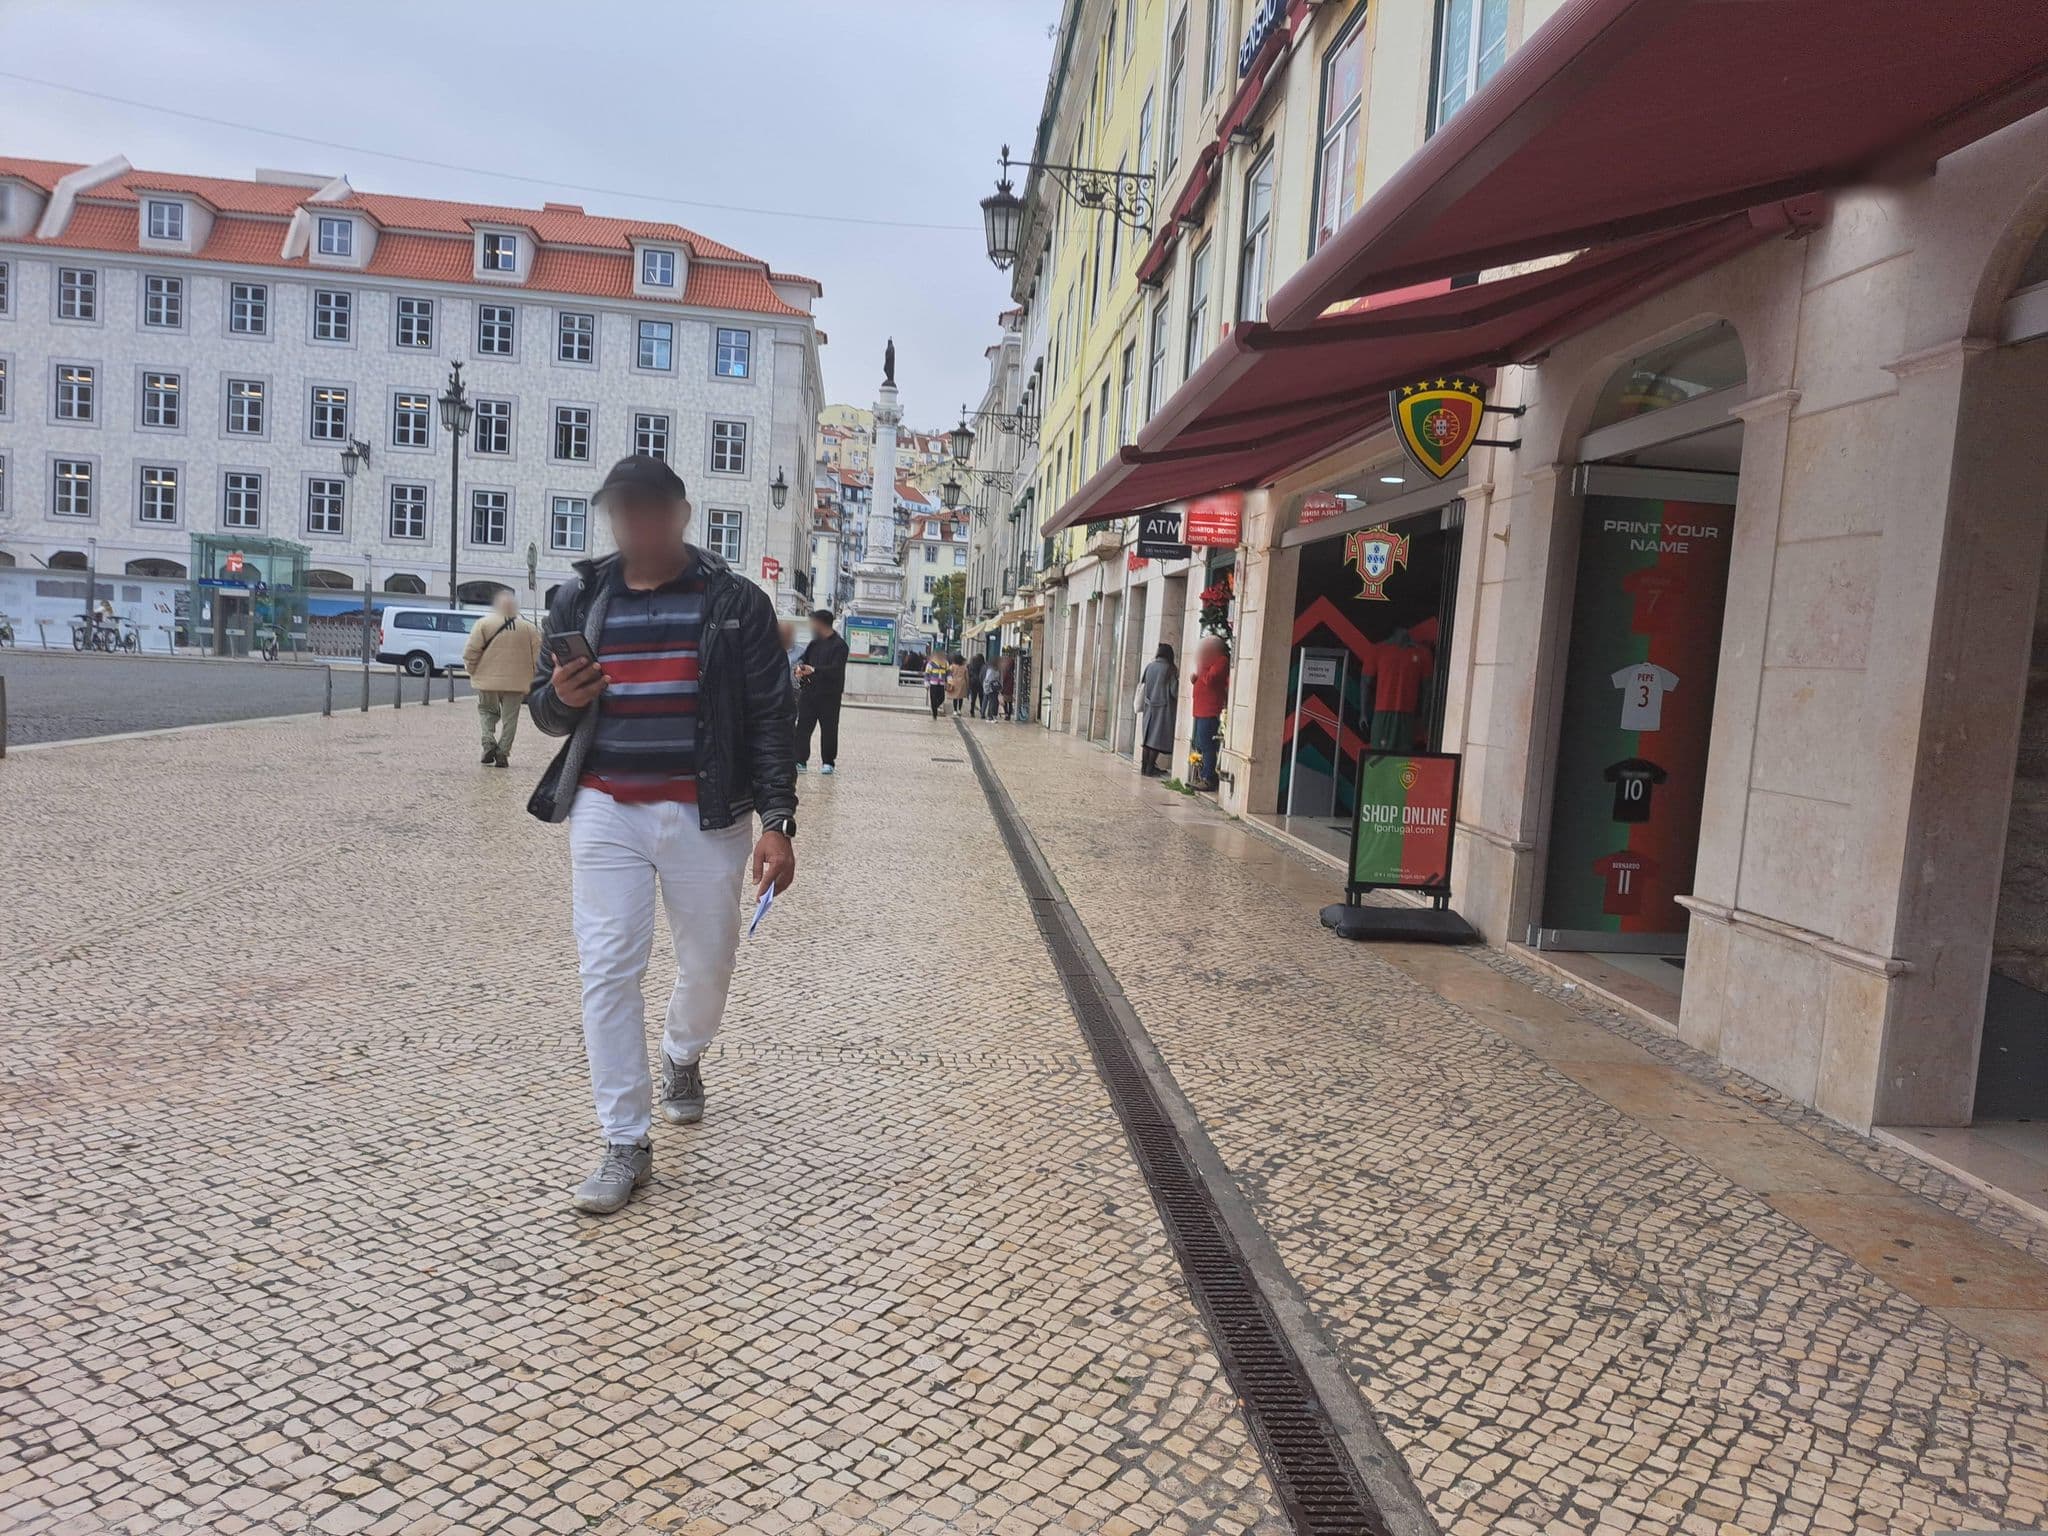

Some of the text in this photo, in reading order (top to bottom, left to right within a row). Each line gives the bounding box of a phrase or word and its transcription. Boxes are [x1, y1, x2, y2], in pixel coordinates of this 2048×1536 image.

[1146, 519, 1181, 535] ATM
[1603, 519, 1719, 539] PRINT YOUR
[1630, 539, 1689, 554] NAME
[1637, 672, 1654, 682] PEPE
[1638, 685, 1649, 708] 3
[1624, 779, 1643, 800] 10
[1362, 804, 1448, 826] SHOP ONLINE
[1618, 869, 1632, 894] 11
